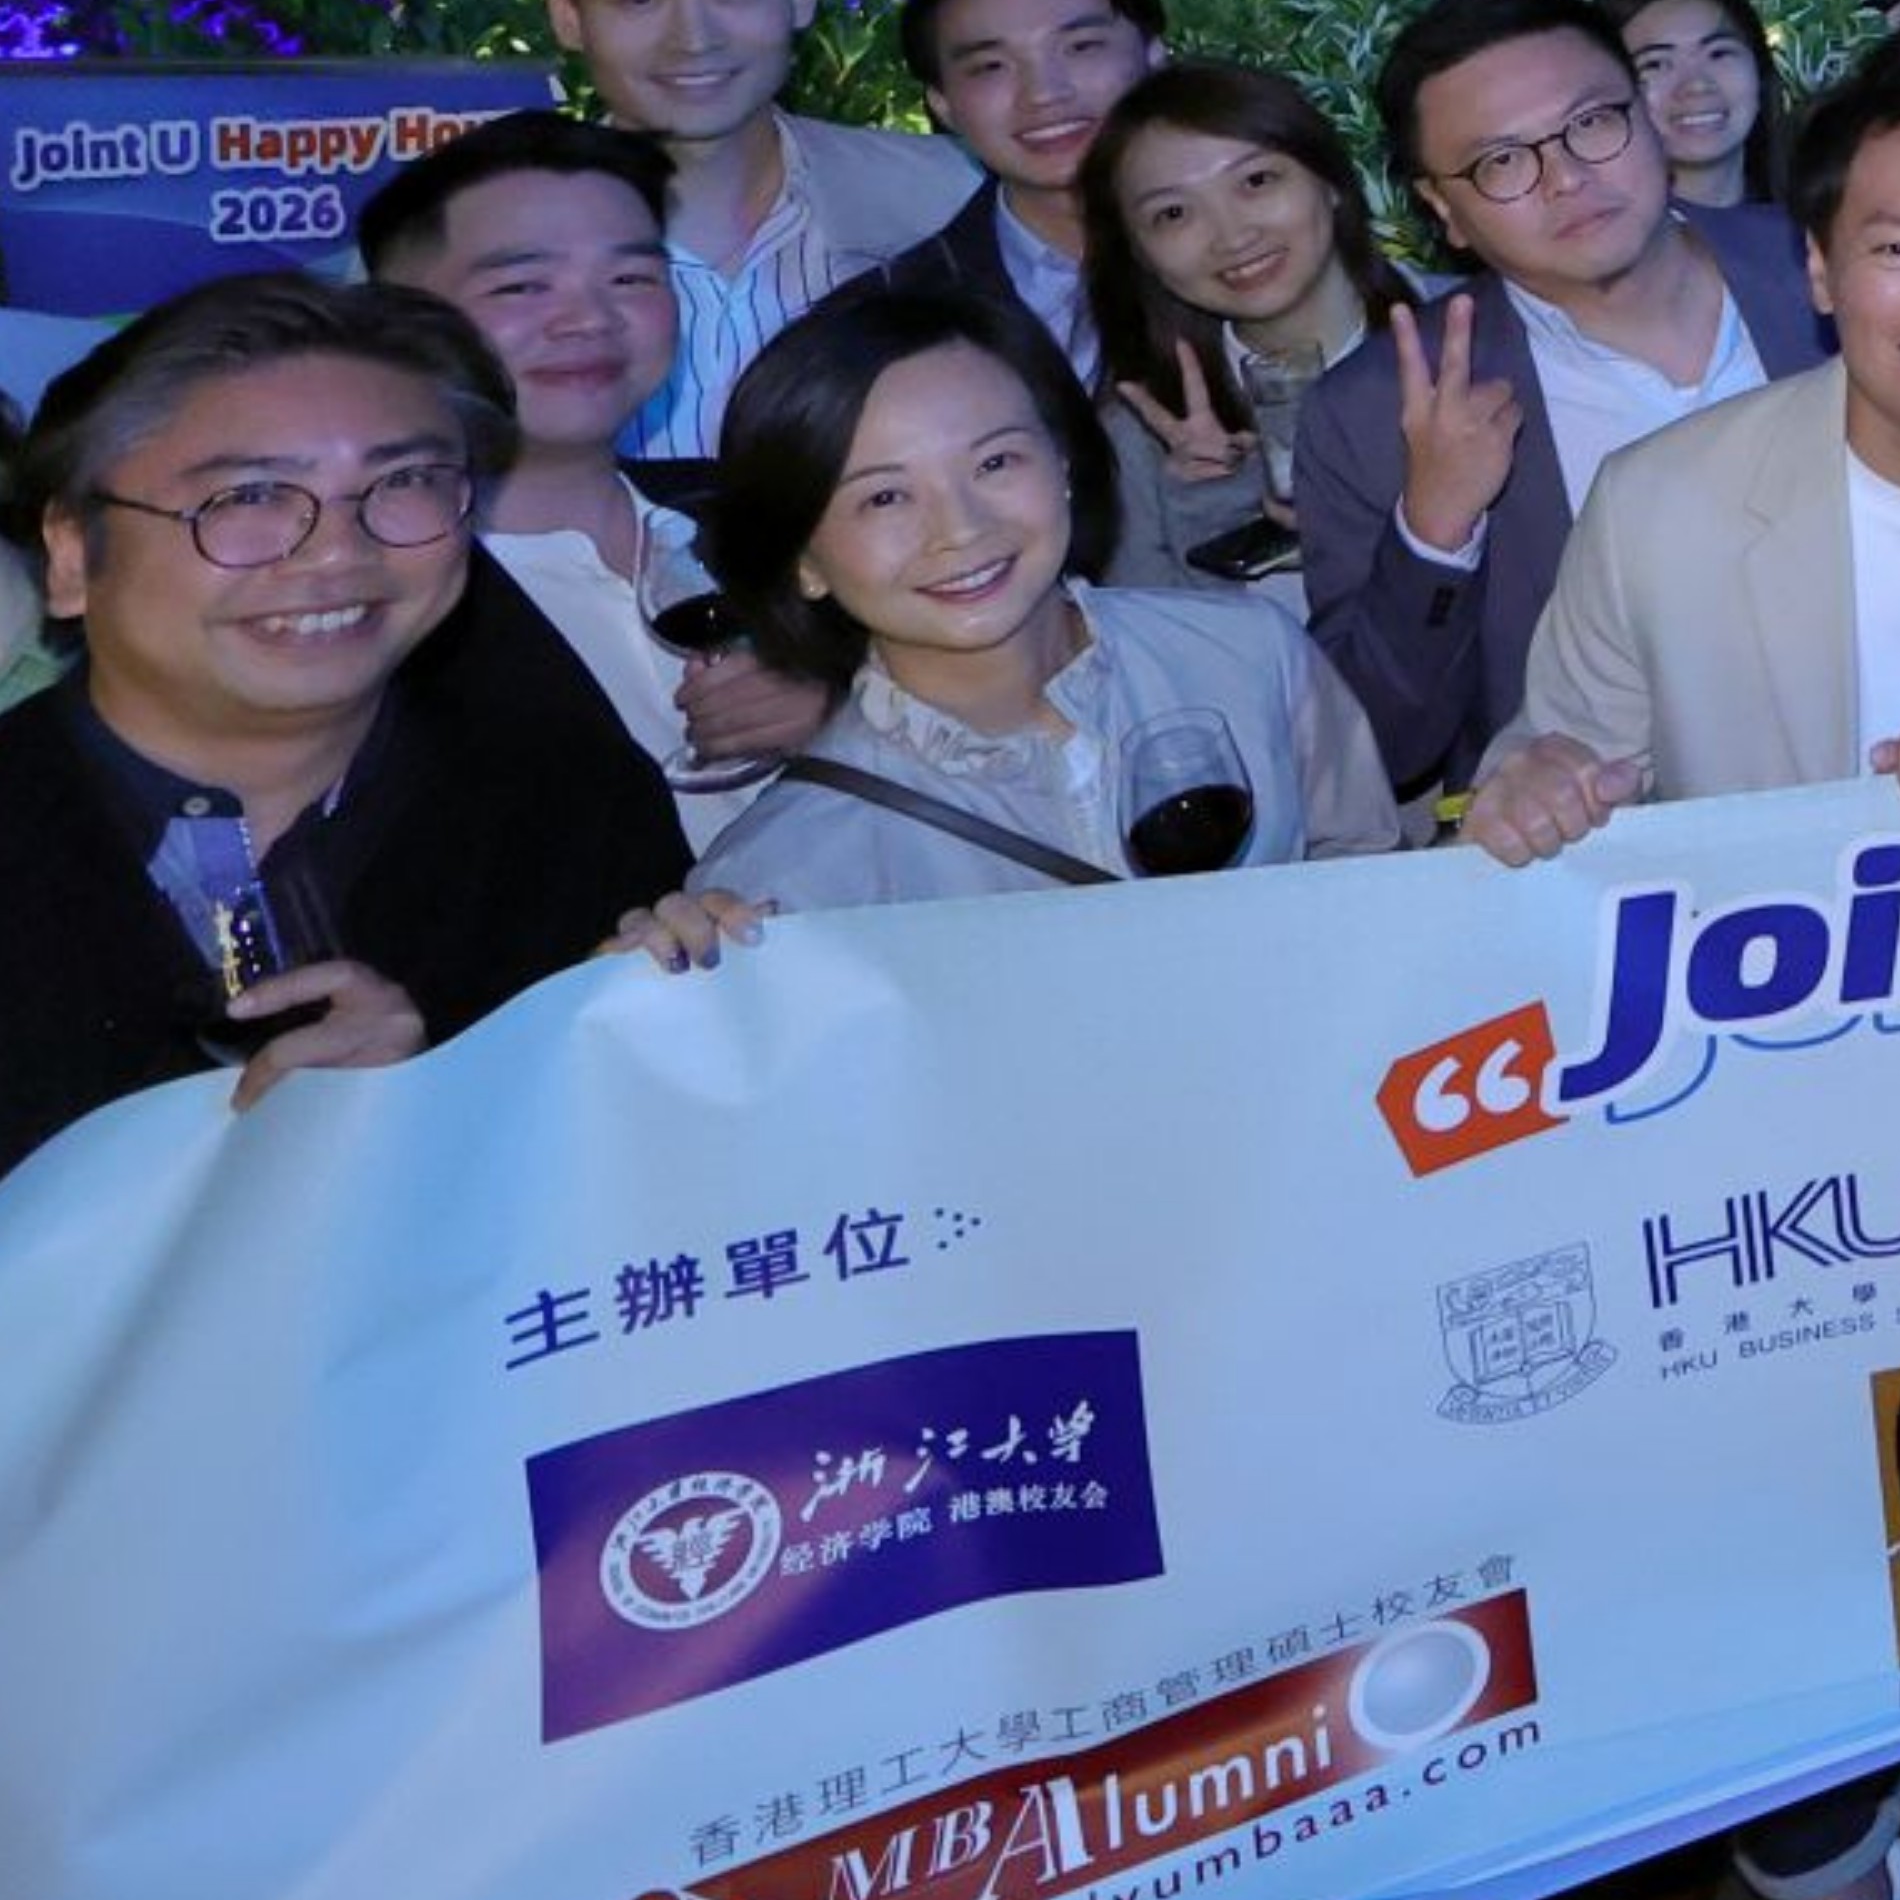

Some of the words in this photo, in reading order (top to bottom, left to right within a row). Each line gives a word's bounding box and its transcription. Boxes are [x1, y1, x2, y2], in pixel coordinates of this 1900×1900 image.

[14, 128, 143, 183] Joint
[157, 127, 193, 168] U
[216, 122, 379, 169] Happy
[216, 196, 341, 236] 2026
[504, 1207, 911, 1371] 主辦單位
[1661, 1349, 1718, 1380] HKU
[1739, 1312, 1877, 1358] BUSINESS
[777, 1506, 934, 1578] 经济学院
[948, 1480, 1110, 1525] 港澳校友会
[686, 1551, 1518, 1867] 香港理工大學工商管理碩士校友會
